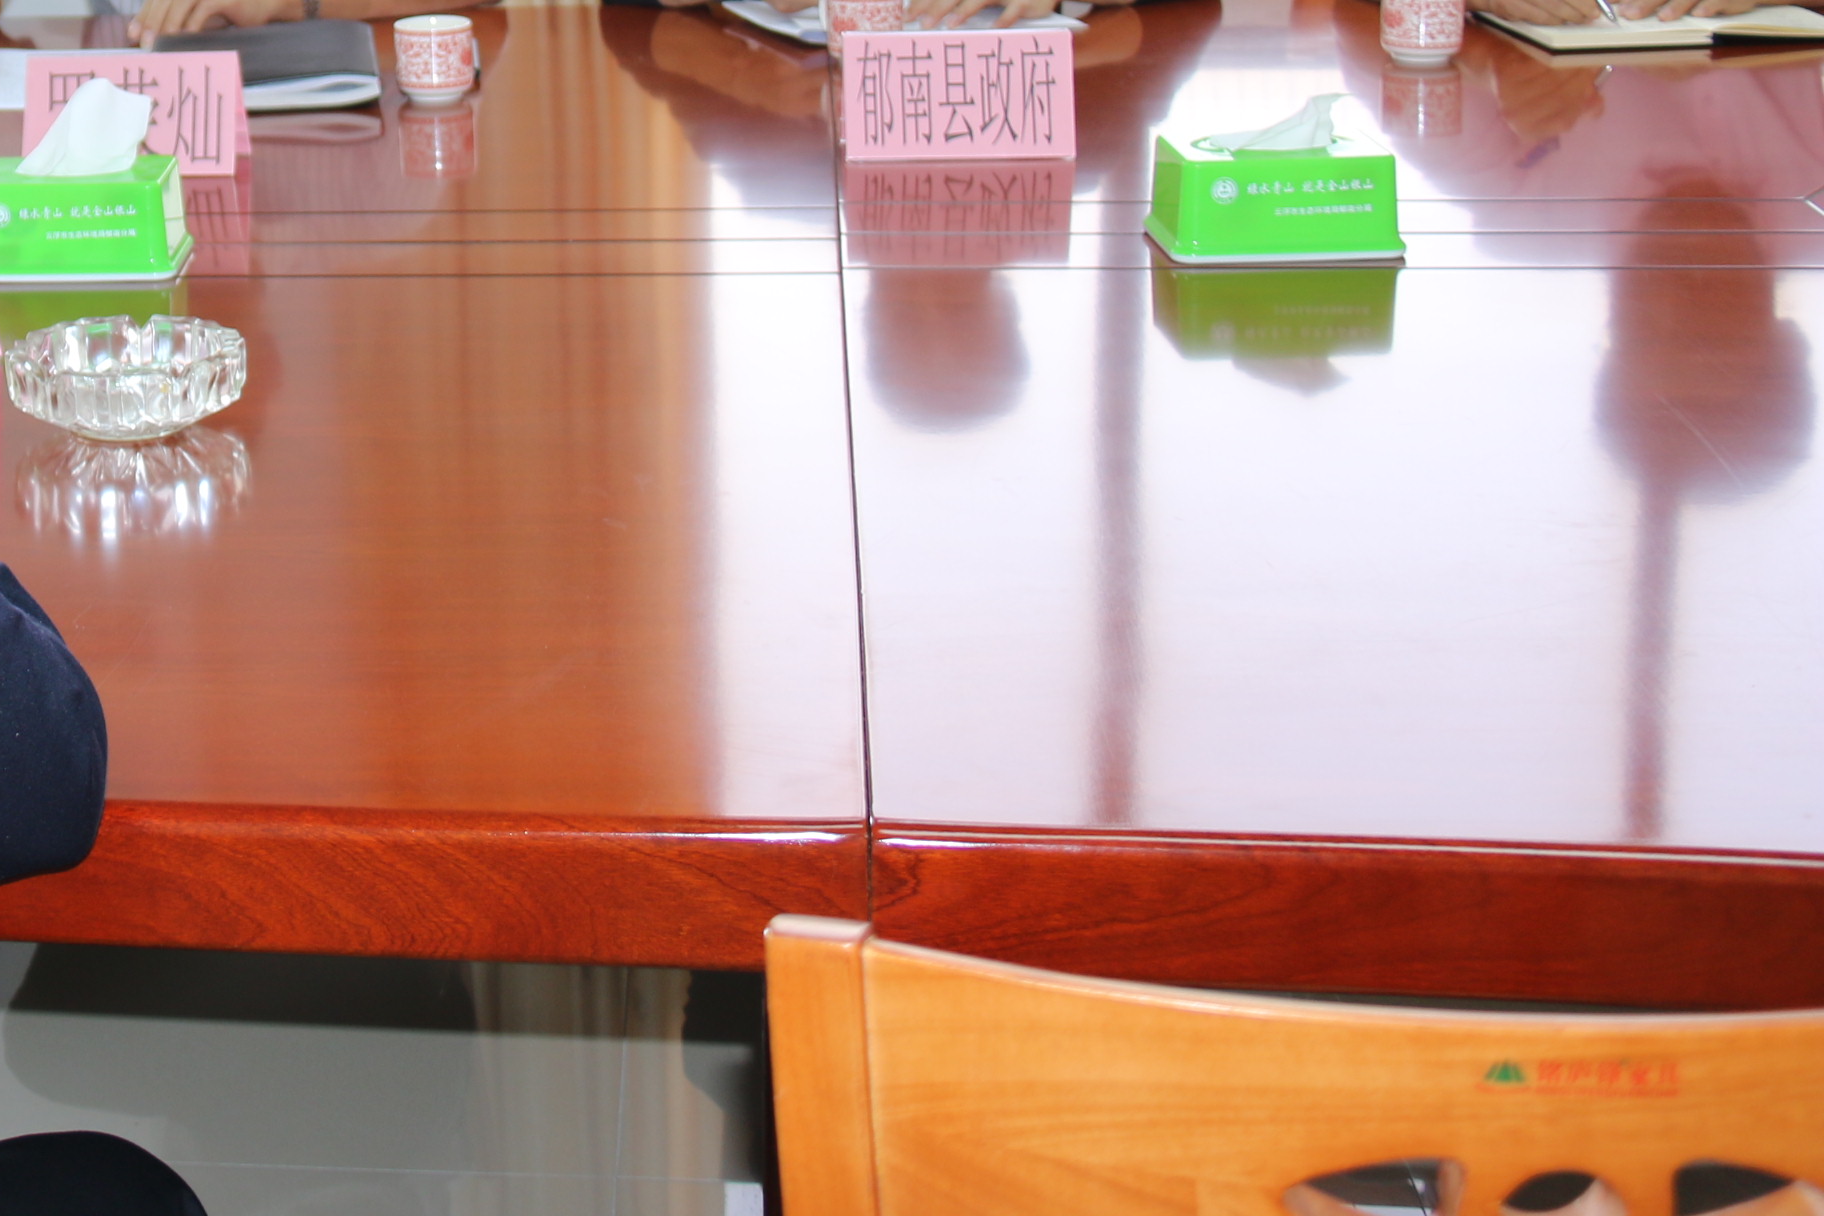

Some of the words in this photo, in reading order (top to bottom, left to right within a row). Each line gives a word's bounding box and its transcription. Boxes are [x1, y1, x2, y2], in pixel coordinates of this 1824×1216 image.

[856, 36, 1056, 146] 郁南县政府
